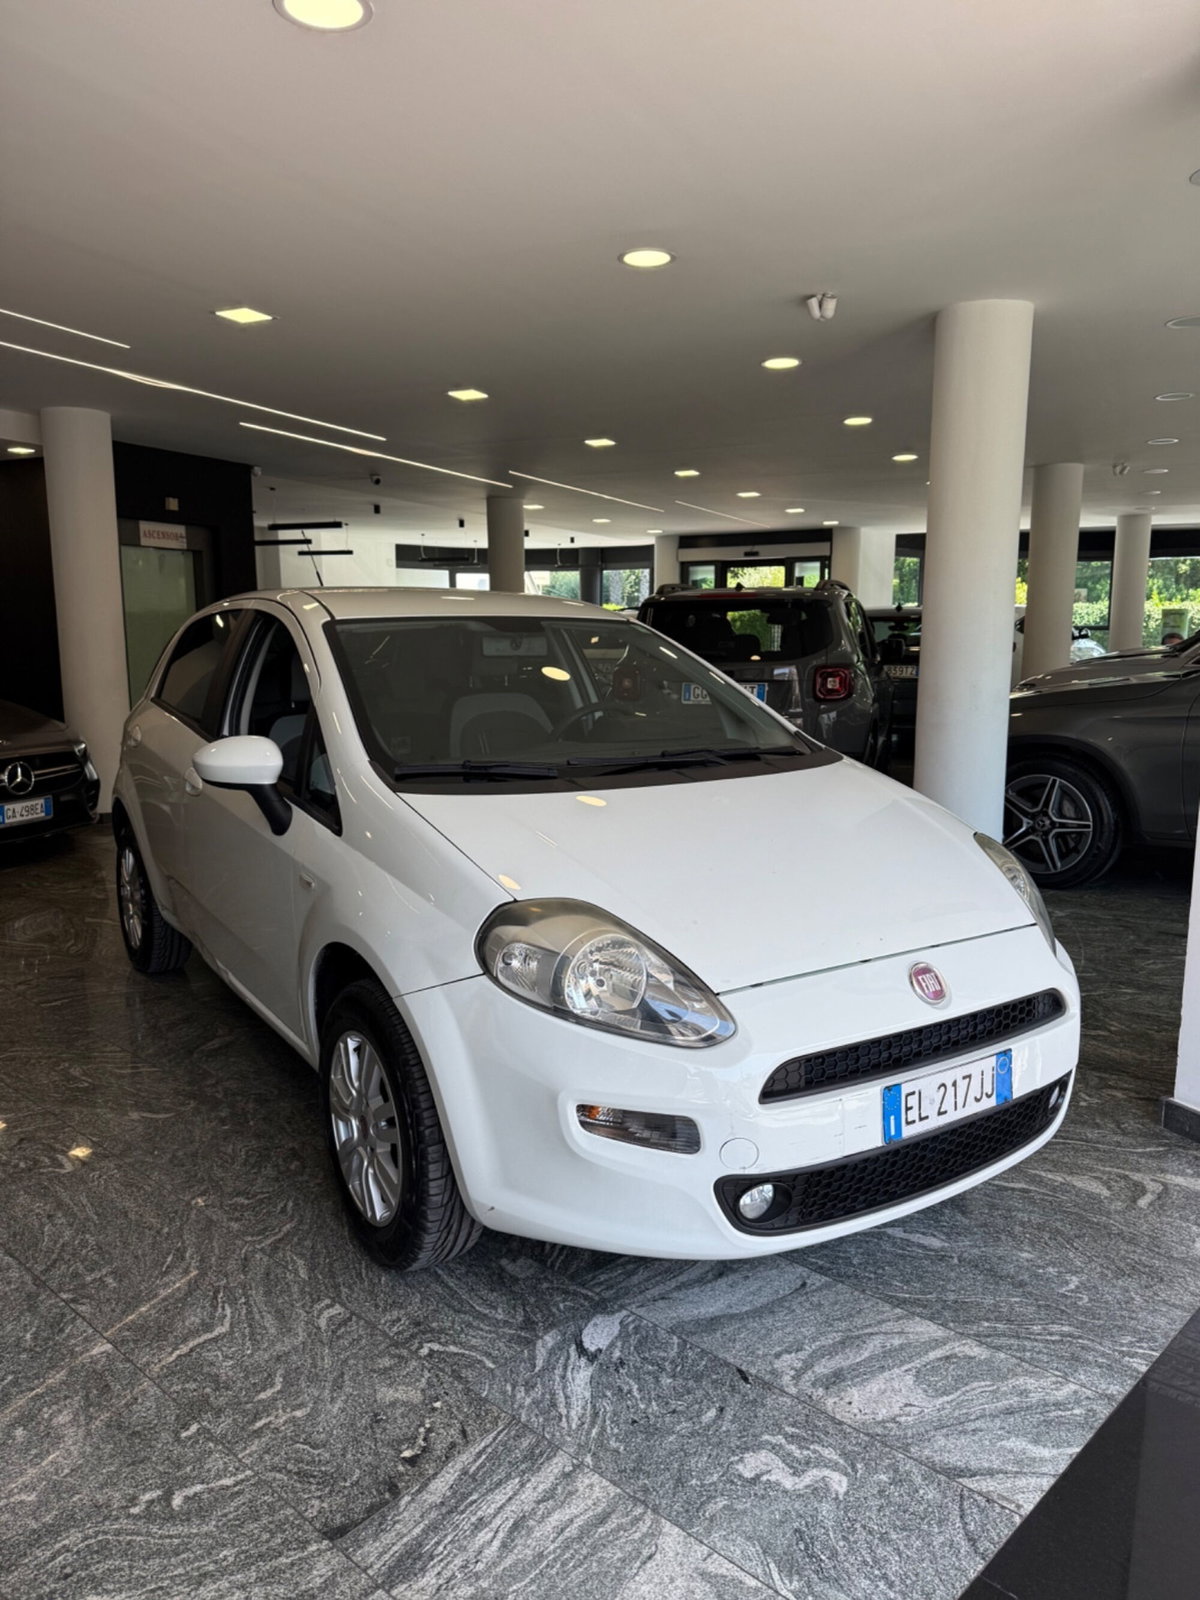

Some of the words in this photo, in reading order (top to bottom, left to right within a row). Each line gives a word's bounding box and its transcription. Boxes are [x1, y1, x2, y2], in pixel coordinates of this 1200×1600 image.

[917, 972, 941, 993] FIAT
[905, 1089, 929, 1126] EL
[937, 1066, 995, 1117] 217JJ
